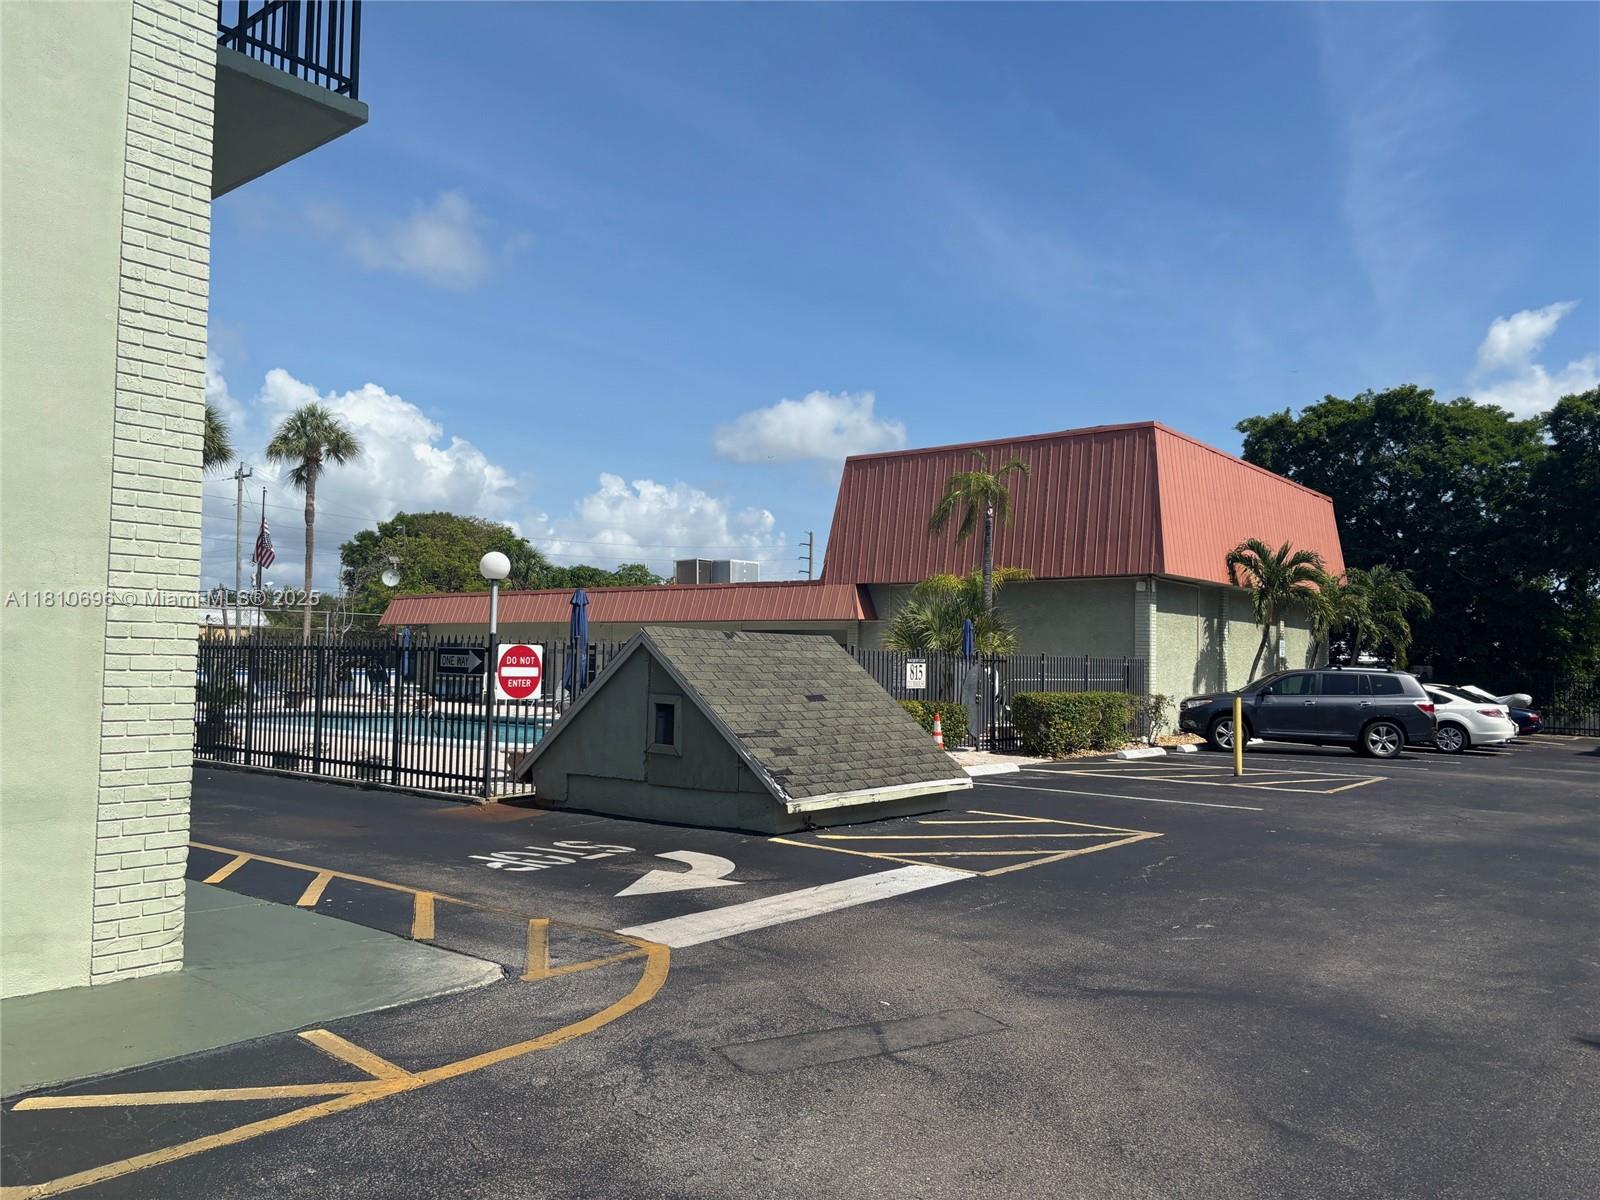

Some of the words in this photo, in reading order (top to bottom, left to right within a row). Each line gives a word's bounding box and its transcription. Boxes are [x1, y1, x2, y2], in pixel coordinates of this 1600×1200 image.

[441, 655, 455, 666] ONE
[456, 655, 470, 667] WAY
[506, 656, 517, 665] DO
[520, 656, 535, 665] NOT
[909, 664, 923, 681] 815
[507, 679, 532, 688] ENTER
[467, 840, 638, 872] STOP
